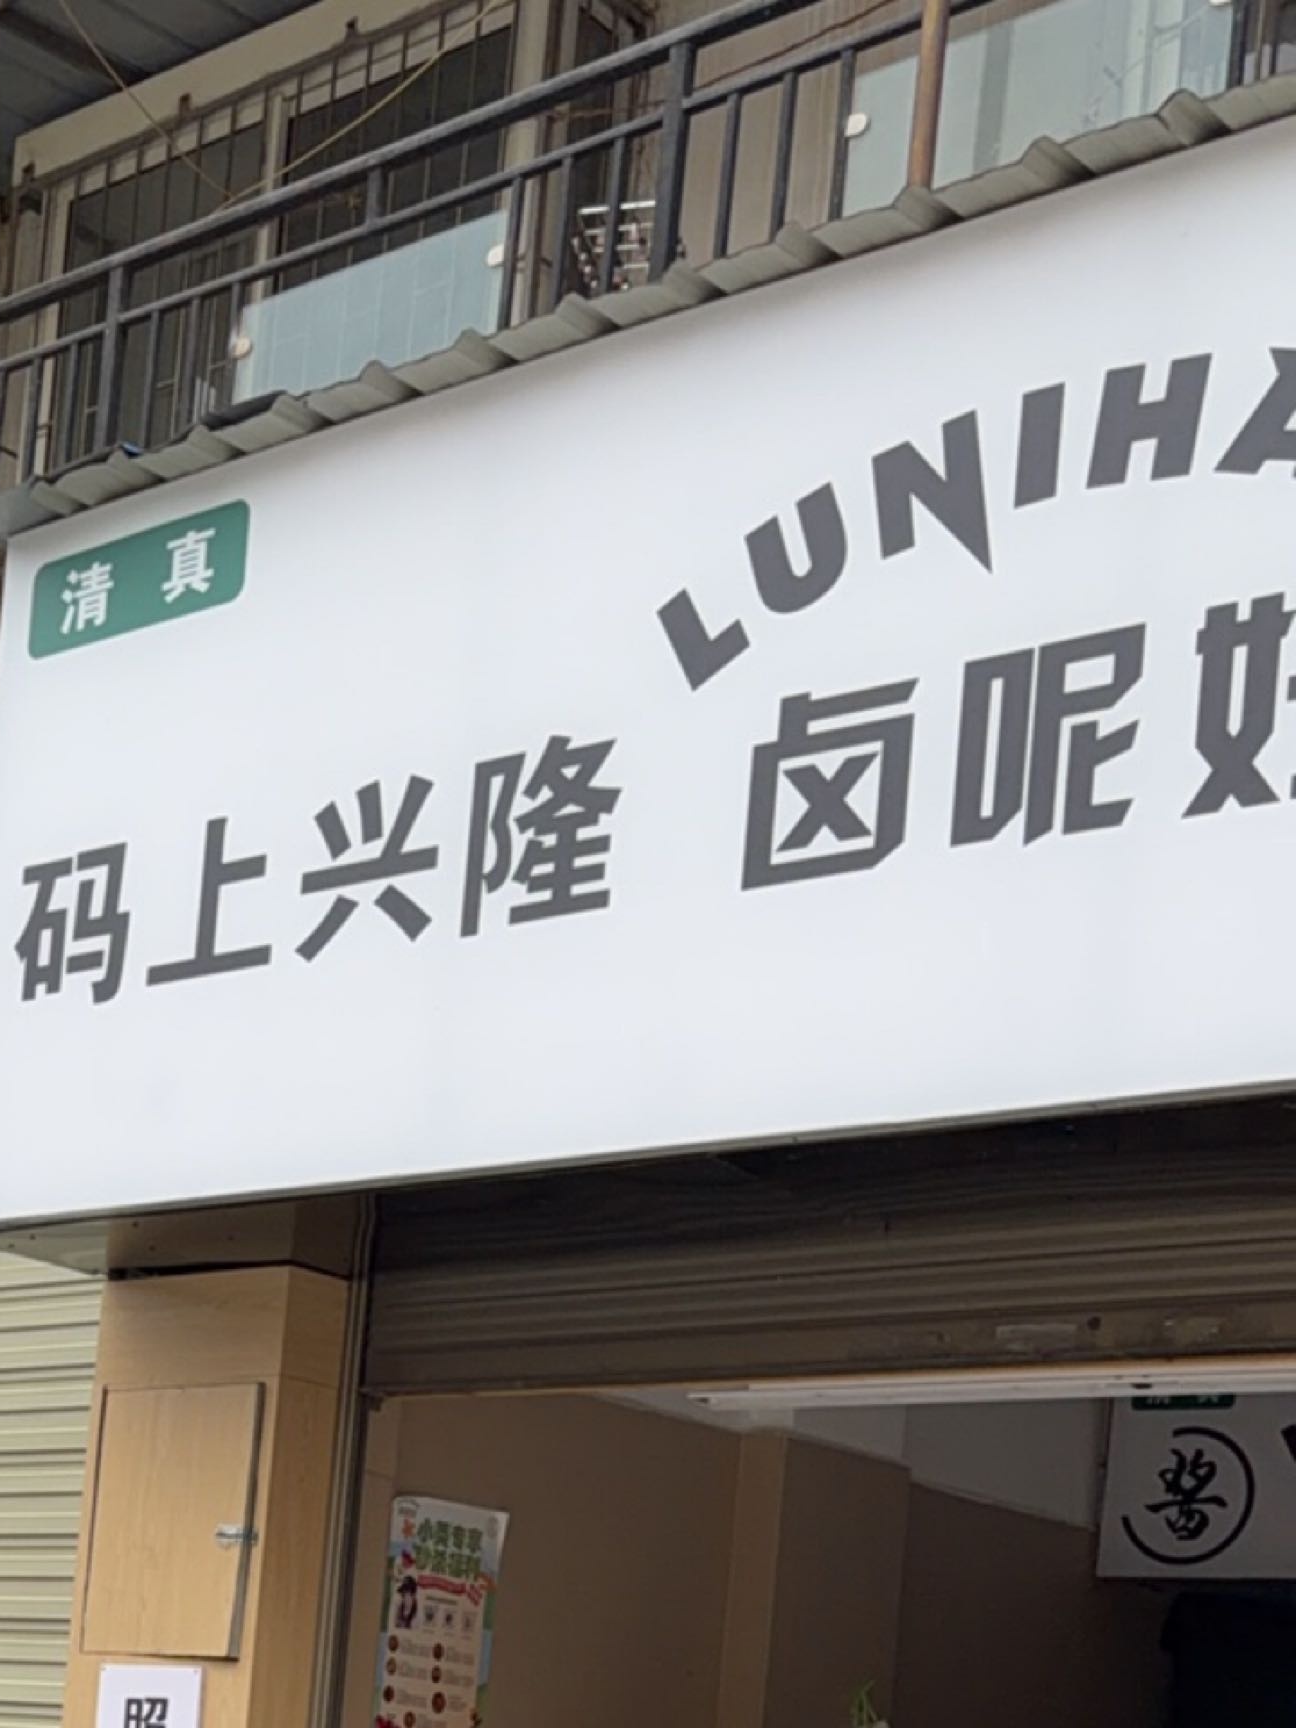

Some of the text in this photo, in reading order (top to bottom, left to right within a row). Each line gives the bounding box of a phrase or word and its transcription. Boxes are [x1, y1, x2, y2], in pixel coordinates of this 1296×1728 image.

[61, 529, 216, 634] 清真
[14, 735, 623, 1005] 码上兴隆
